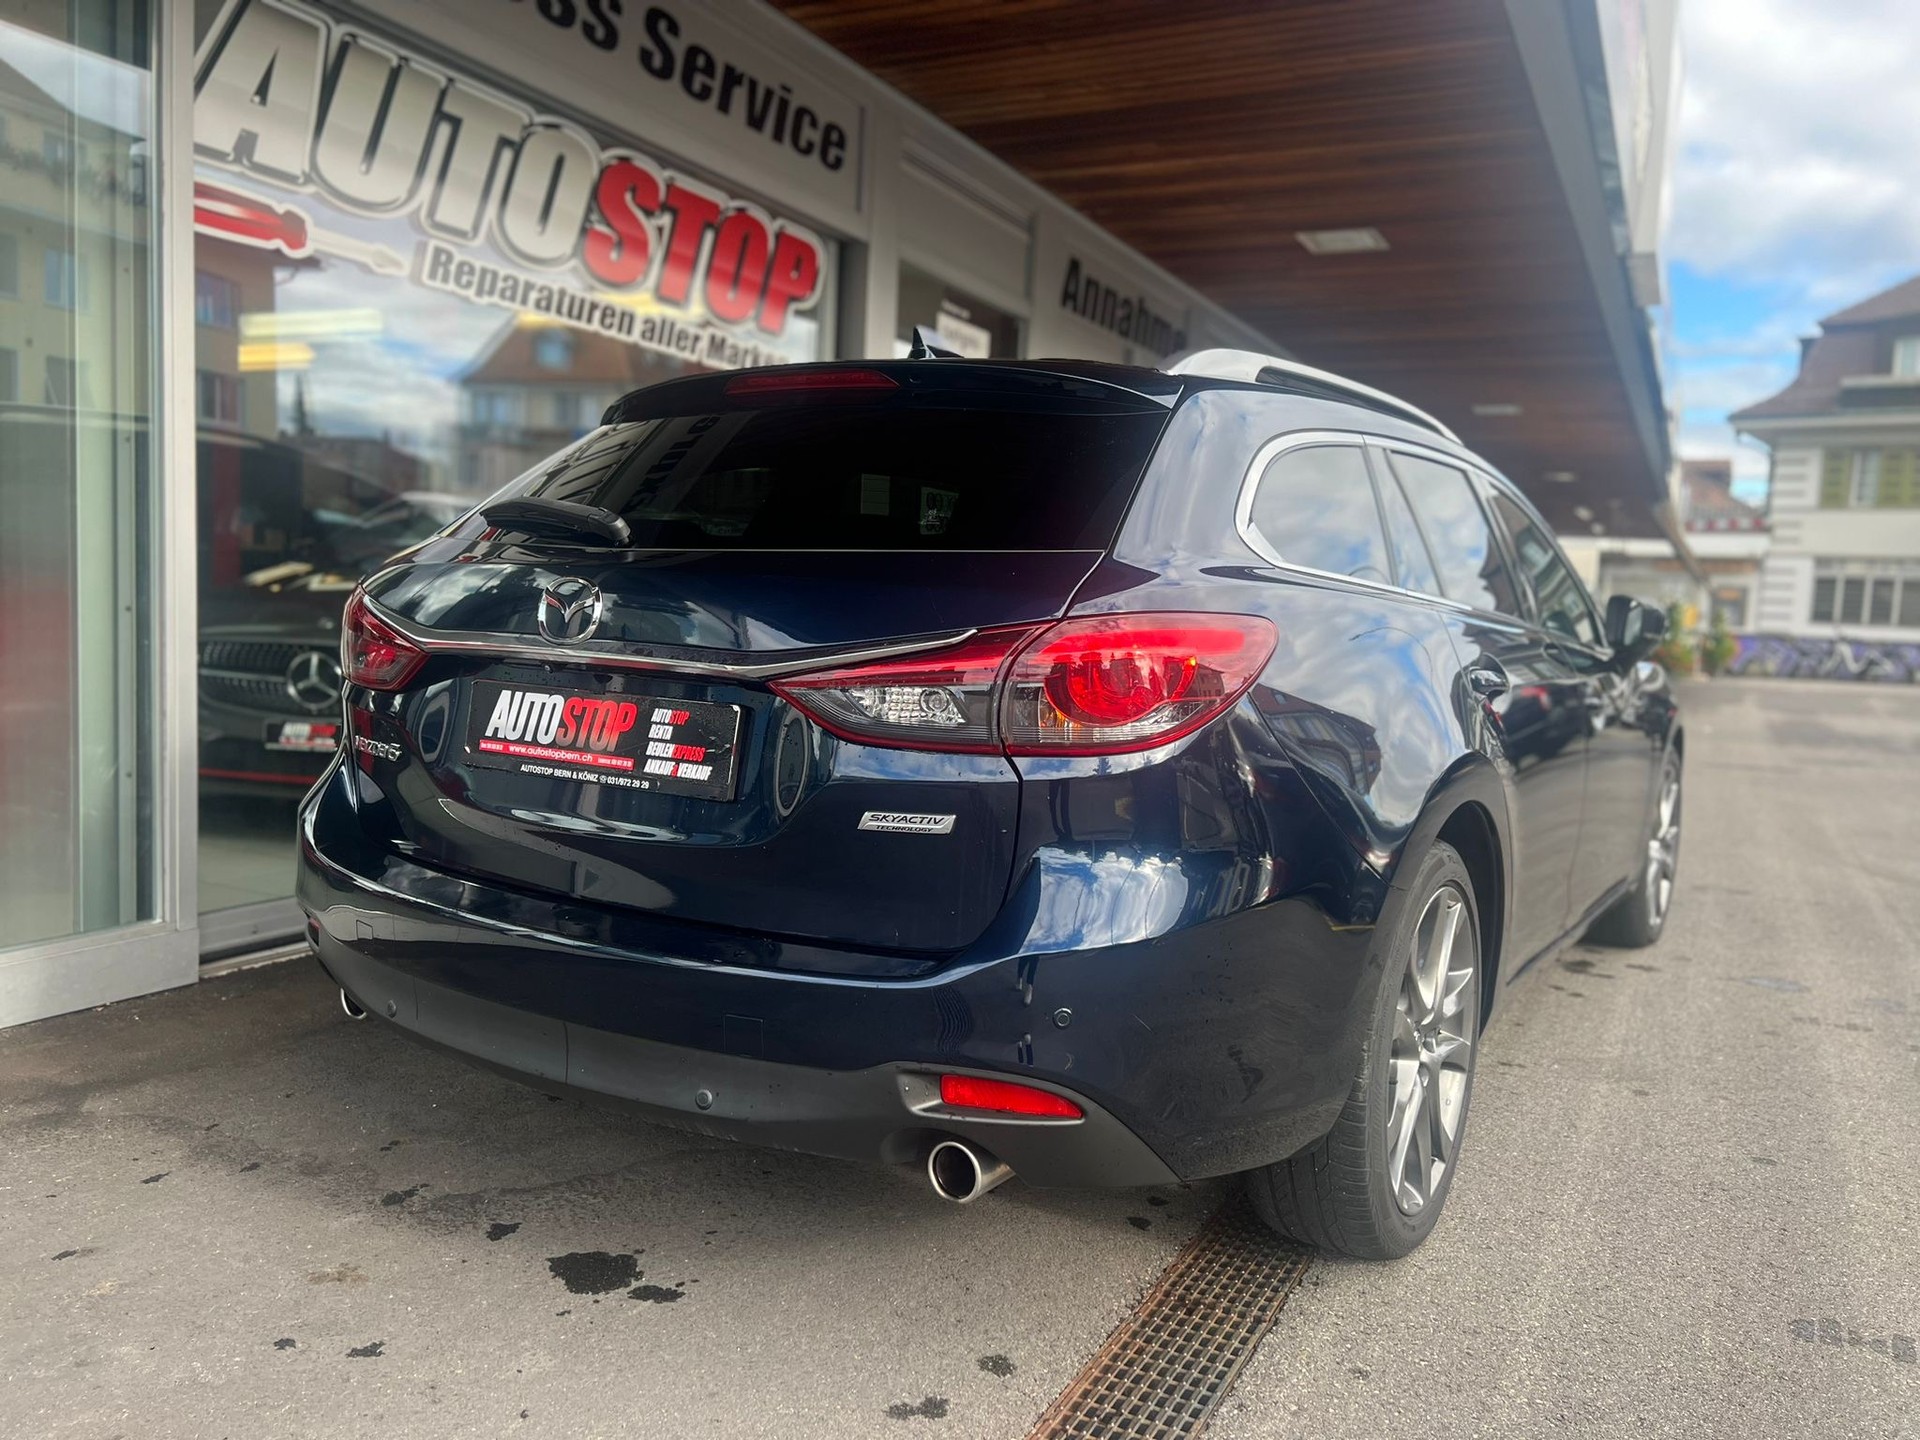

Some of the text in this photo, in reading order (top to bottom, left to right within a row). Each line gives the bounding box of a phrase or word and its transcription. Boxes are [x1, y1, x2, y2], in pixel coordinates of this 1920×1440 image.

[639, 7, 846, 172] Service
[194, 0, 822, 335] AUTOSTOP
[428, 245, 635, 337] Reparaturen
[640, 315, 702, 357] aller
[485, 689, 638, 752] AUTOSTOP
[650, 707, 691, 727] AUTOSTOP
[508, 744, 593, 764] www.autostopbern.ch
[520, 763, 650, 790] AUTOSTOP BERN & KÖNIZ 031/972 29 29
[868, 813, 945, 825] SKYACTIV
[875, 825, 934, 833] TECHNOLOGY
